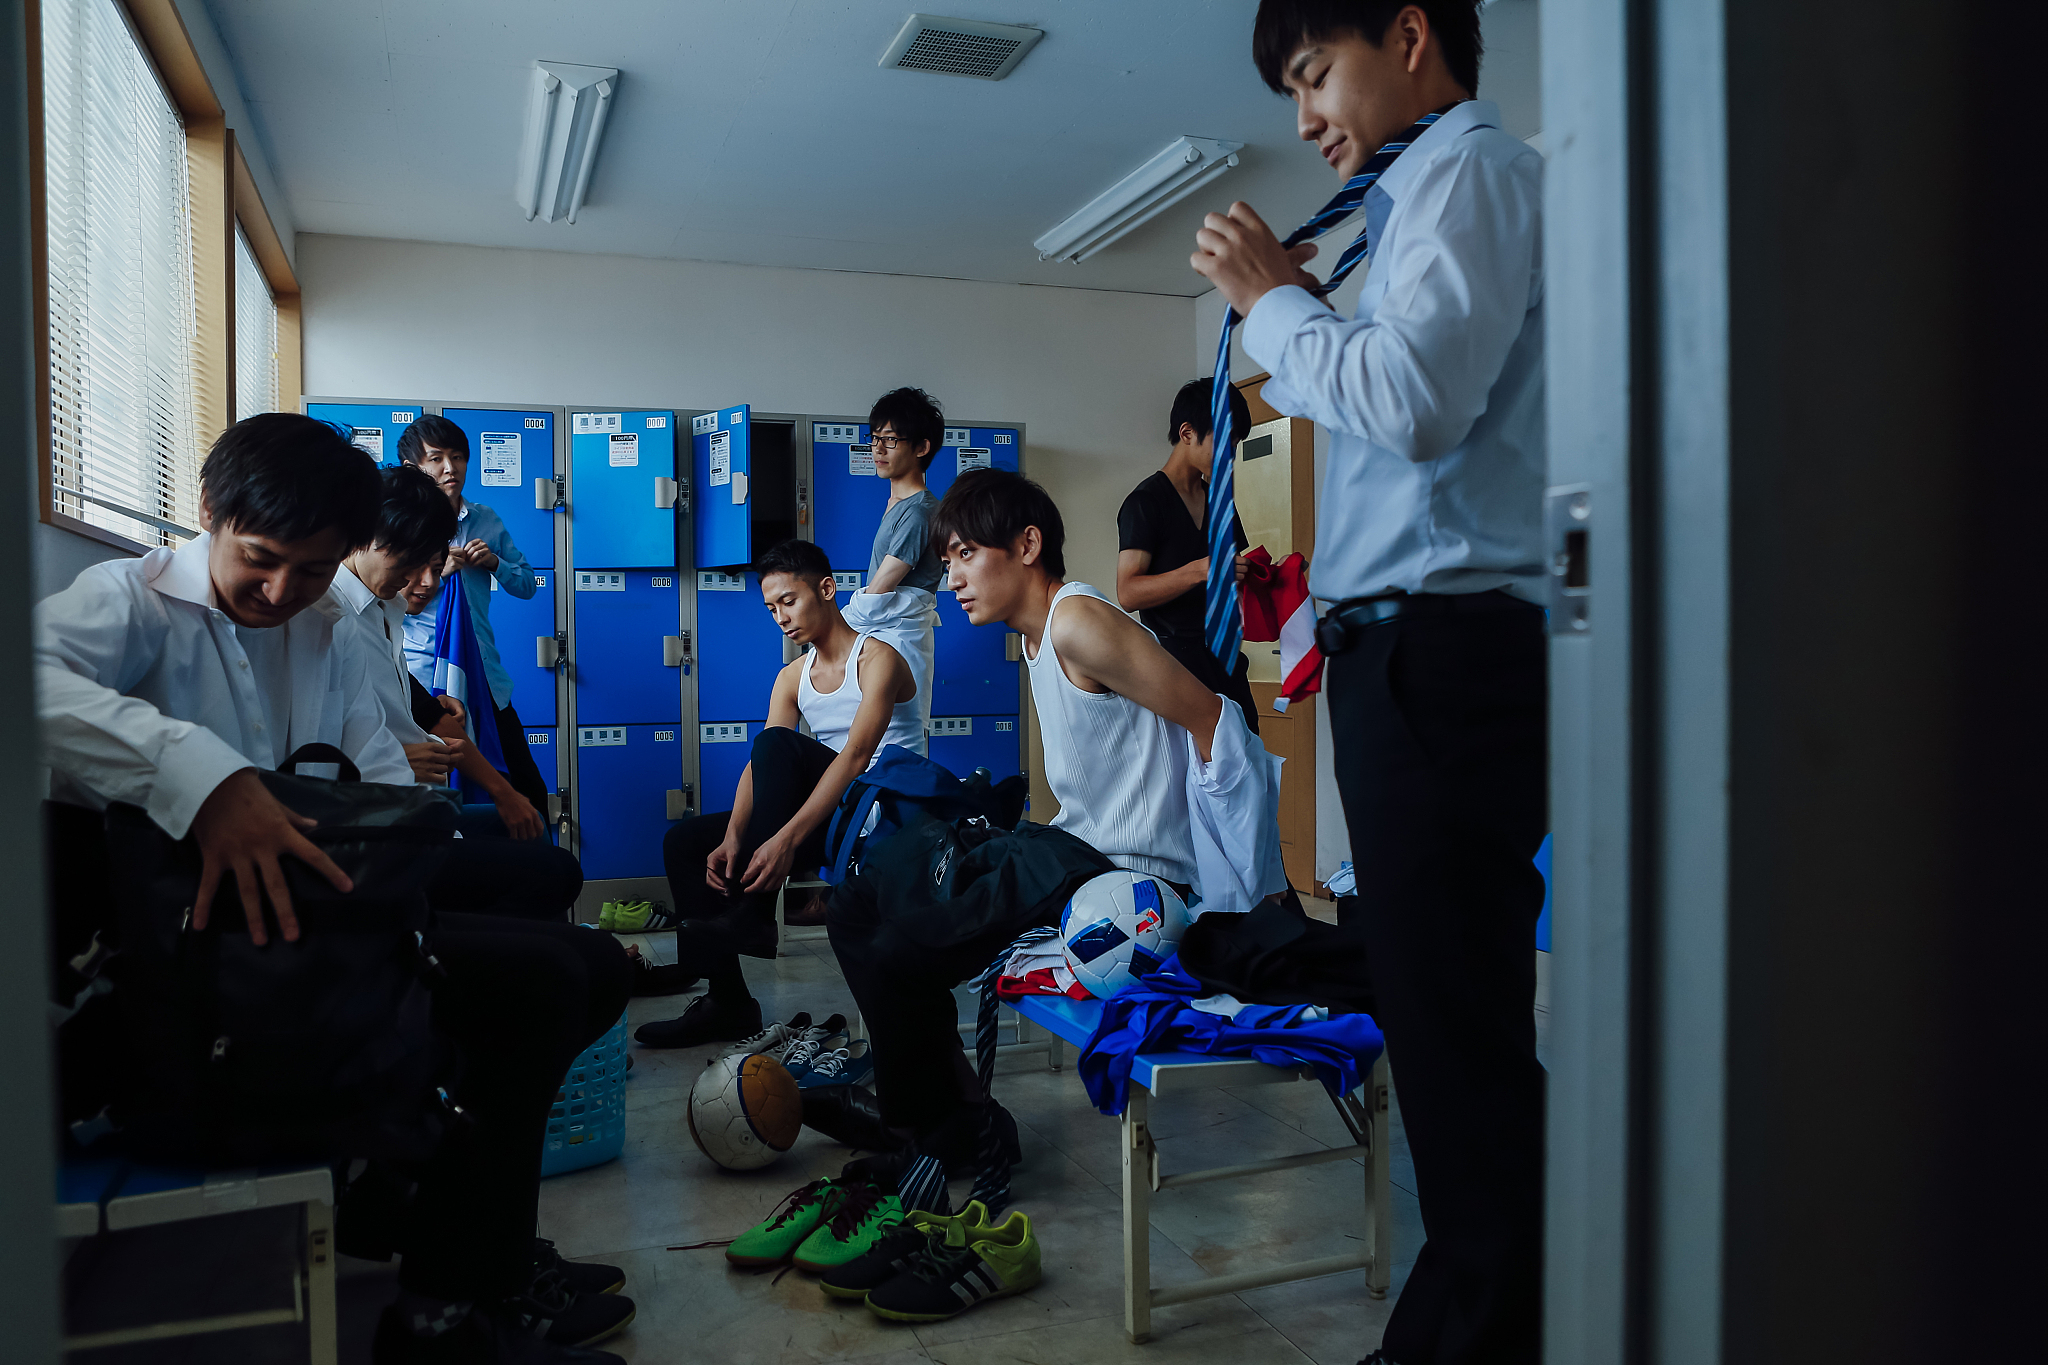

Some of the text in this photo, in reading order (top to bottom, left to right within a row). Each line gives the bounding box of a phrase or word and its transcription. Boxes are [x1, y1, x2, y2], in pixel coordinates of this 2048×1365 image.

[393, 413, 412, 422] 0001
[525, 419, 544, 428] 0004
[647, 418, 665, 428] 0007
[994, 435, 1011, 444] 0016
[652, 578, 671, 586] 0008
[996, 722, 1012, 730] 0018
[529, 734, 548, 744] 0006
[656, 732, 674, 740] 0009
